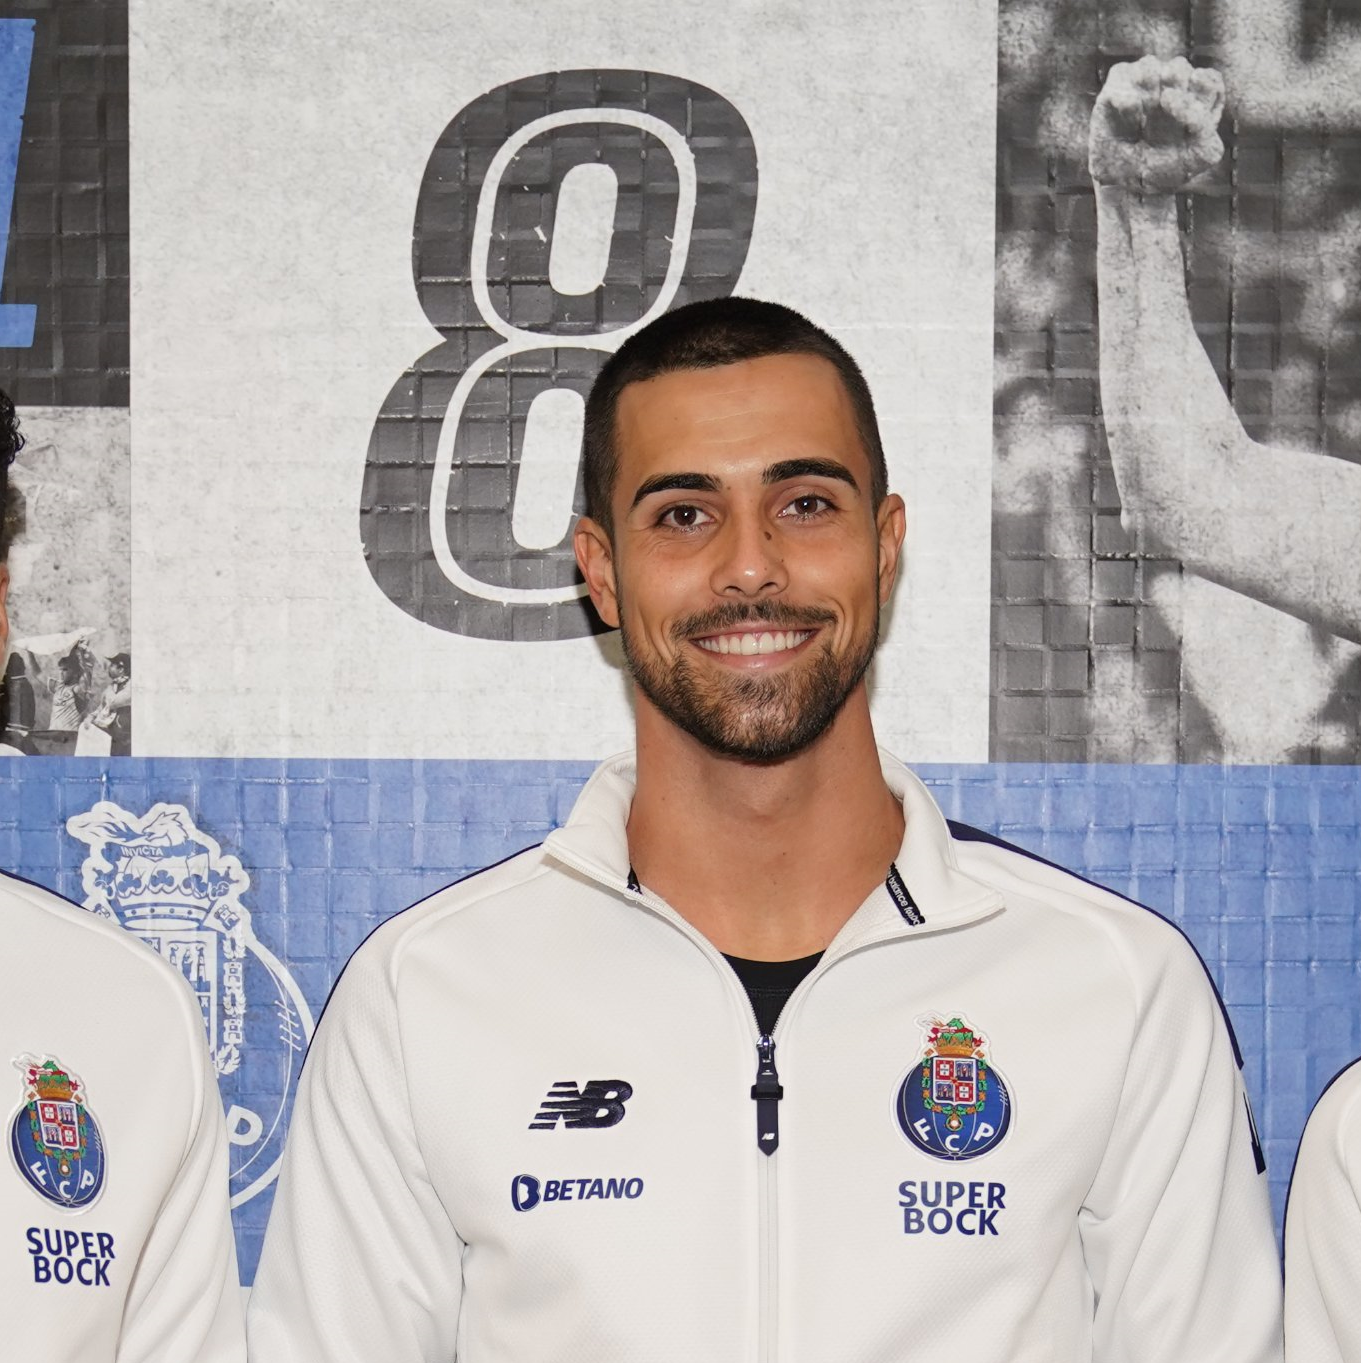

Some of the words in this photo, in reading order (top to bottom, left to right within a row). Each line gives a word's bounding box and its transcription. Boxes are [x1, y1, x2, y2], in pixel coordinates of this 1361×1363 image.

[359, 69, 759, 641] 8
[121, 845, 165, 857] INVICTA
[528, 1080, 633, 1130] NB
[543, 1177, 644, 1202] BETANO
[898, 1181, 1006, 1209] SUPER
[903, 1207, 999, 1236] BOCK
[26, 1227, 116, 1259] SUPER
[33, 1255, 111, 1287] BOCK
